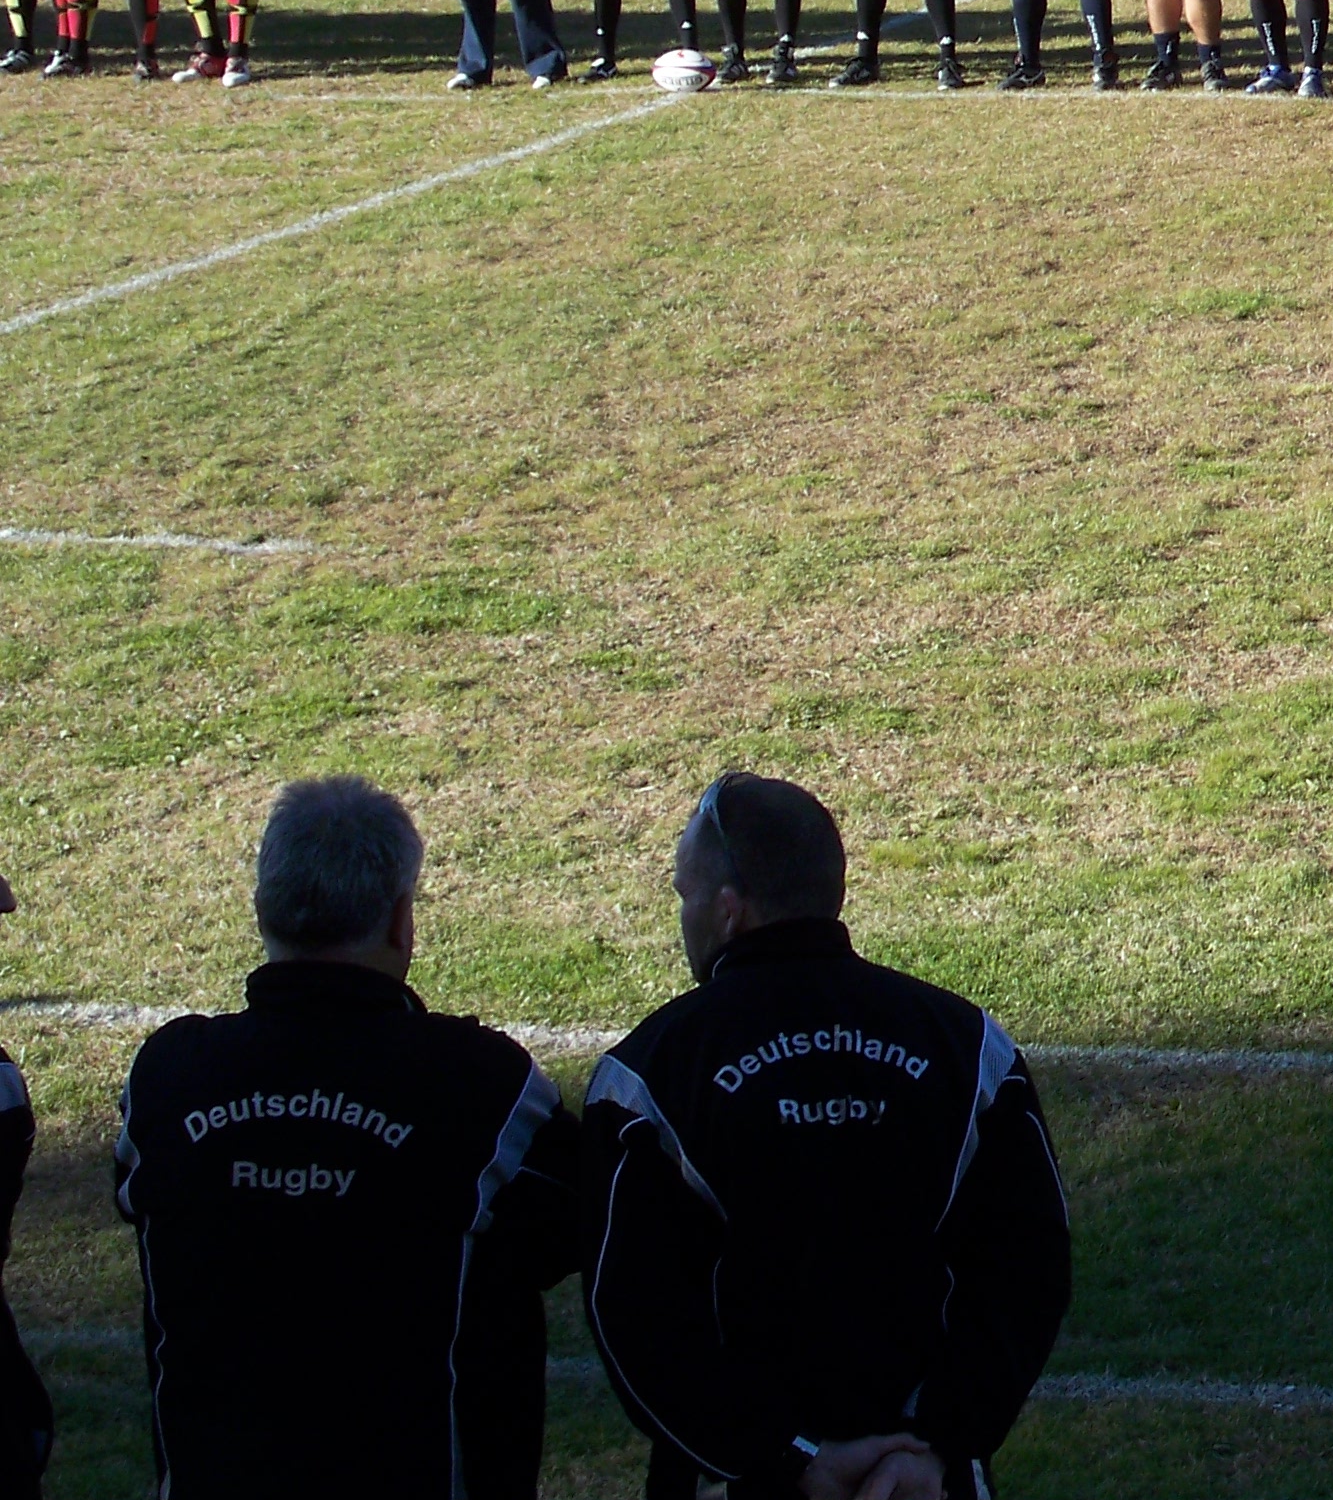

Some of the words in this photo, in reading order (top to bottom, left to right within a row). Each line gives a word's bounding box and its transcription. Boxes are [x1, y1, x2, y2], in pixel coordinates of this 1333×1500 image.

[713, 1024, 929, 1094] Deutschland
[183, 1088, 414, 1149] Deutschland
[778, 1094, 886, 1126] Rugby
[231, 1161, 357, 1197] Rugby
